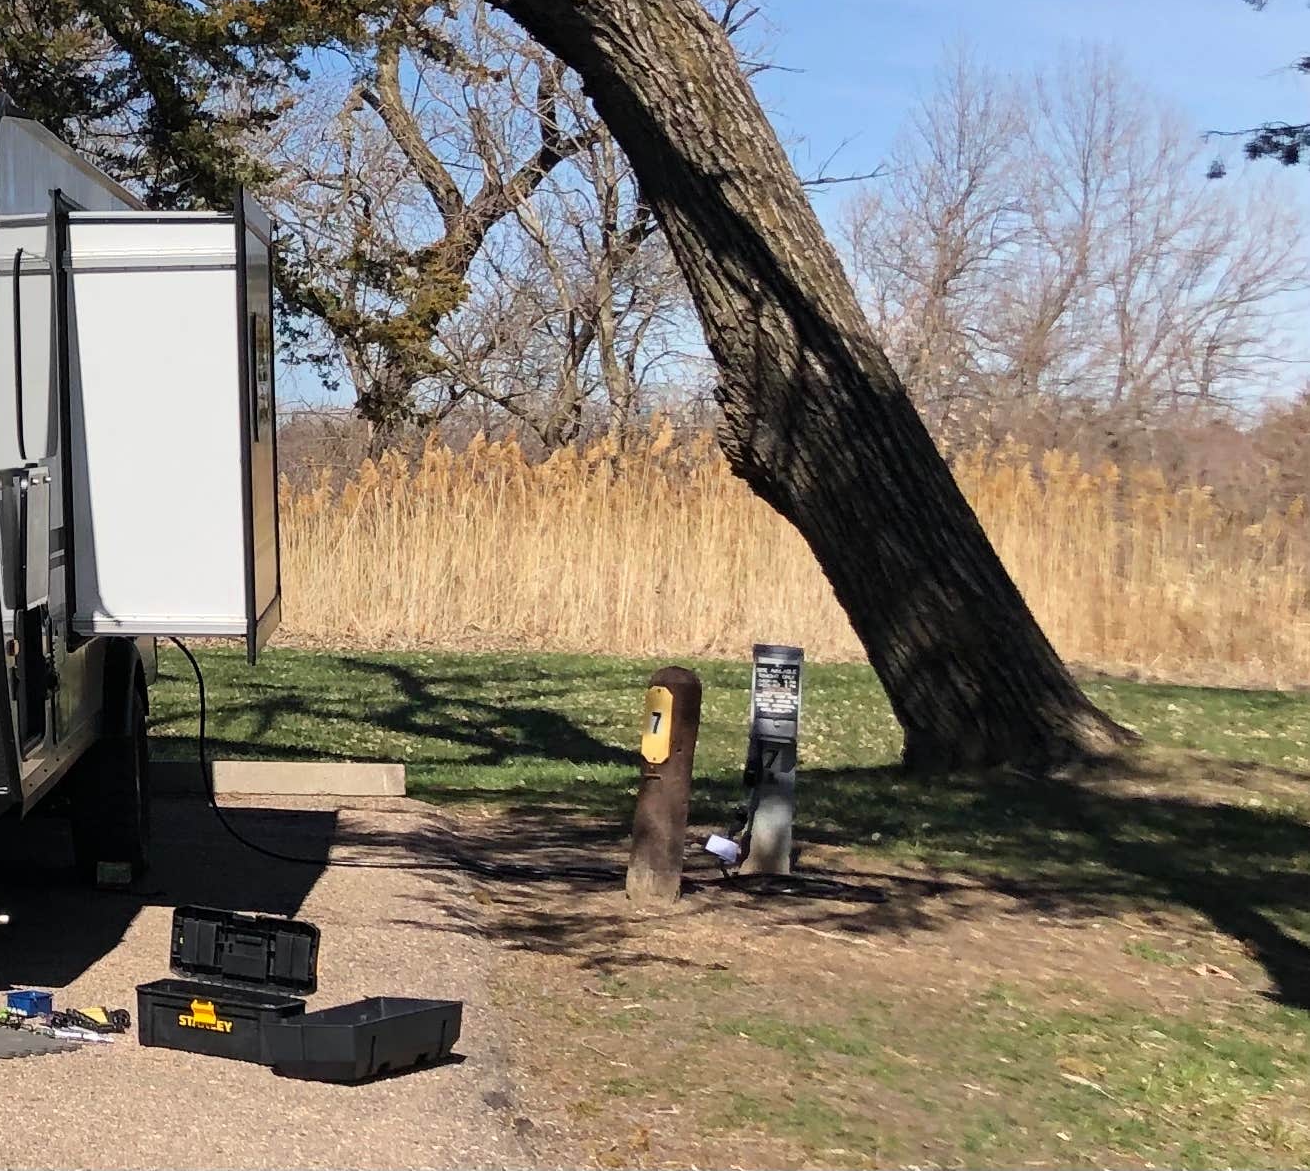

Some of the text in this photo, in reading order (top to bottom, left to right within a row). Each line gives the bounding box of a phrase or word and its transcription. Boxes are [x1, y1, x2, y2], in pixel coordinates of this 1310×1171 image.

[652, 711, 661, 734] 7
[763, 748, 779, 768] 7
[179, 1014, 232, 1032] STEY
